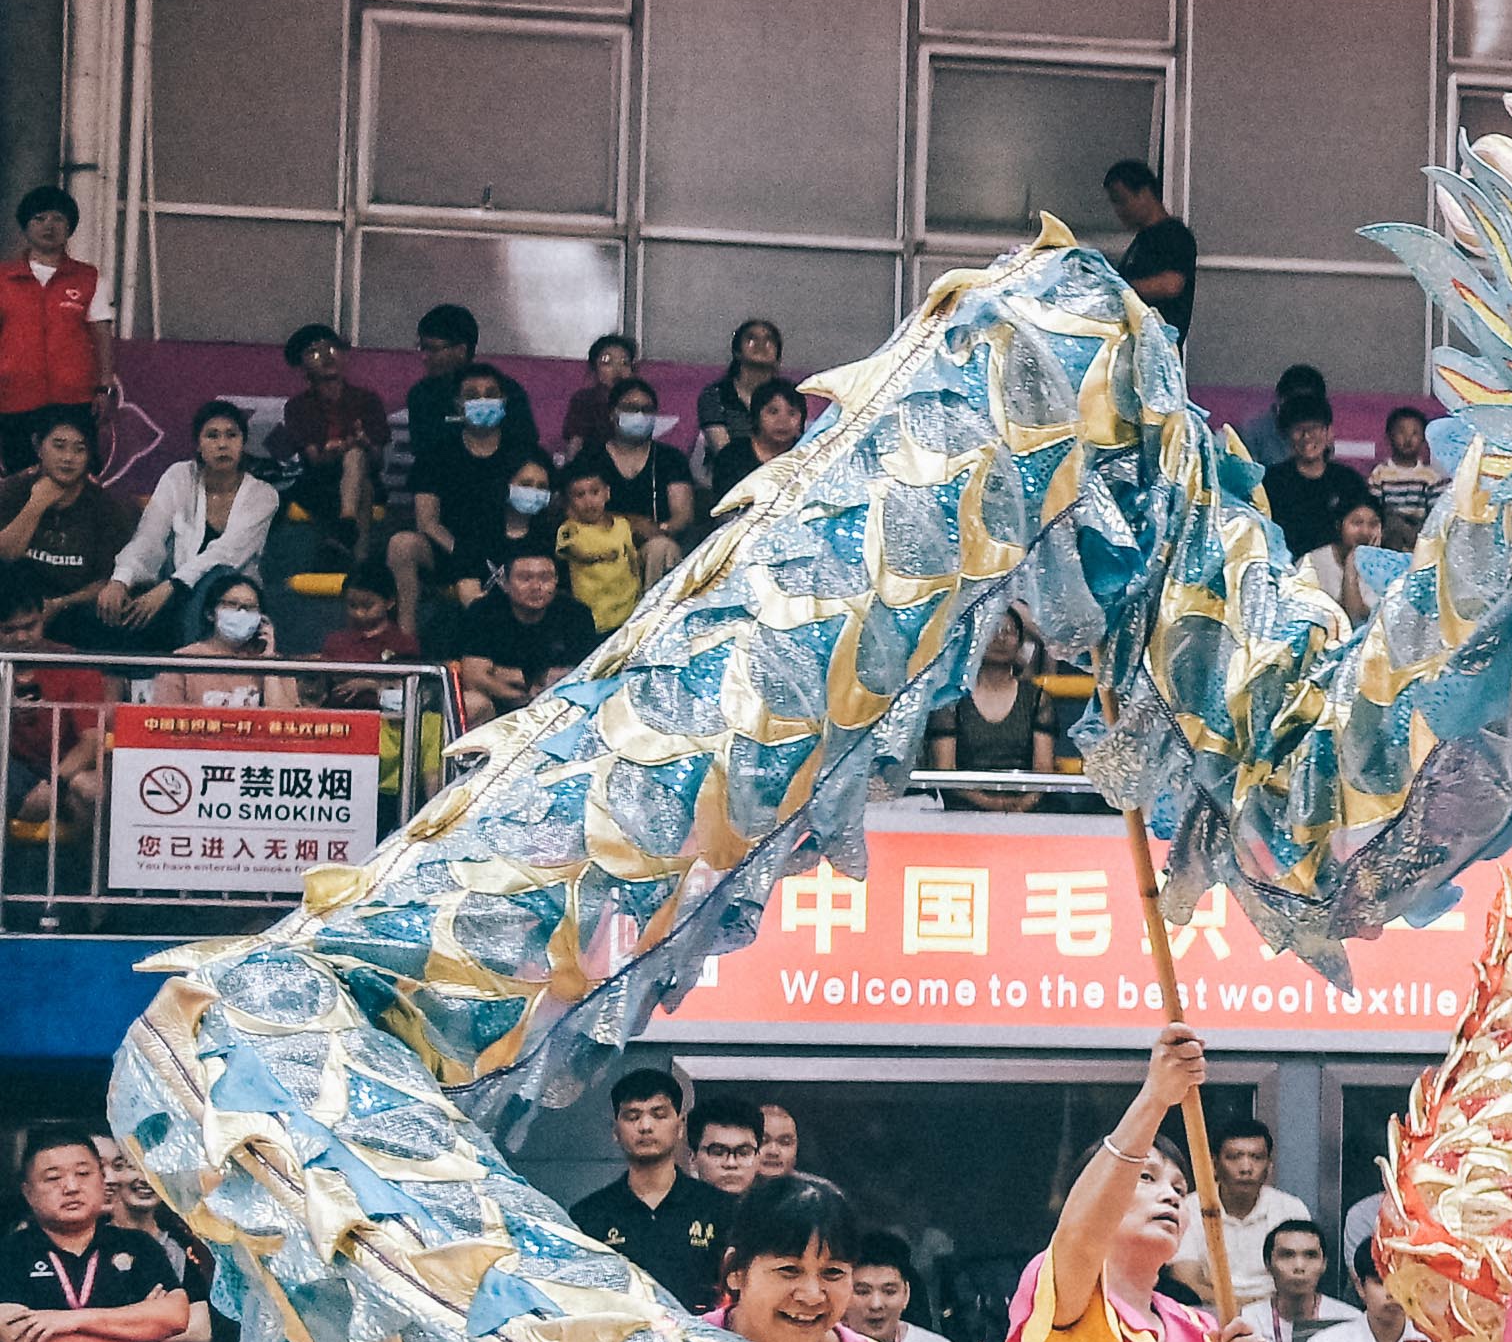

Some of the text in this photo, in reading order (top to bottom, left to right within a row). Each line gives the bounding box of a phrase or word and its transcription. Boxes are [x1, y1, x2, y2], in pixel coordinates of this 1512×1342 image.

[200, 765, 352, 801] 严禁吸烟
[198, 802, 351, 823] NO SMOKING
[137, 834, 349, 862] 您已进入无烟区
[780, 969, 976, 1008] Welcome
[990, 973, 1028, 1008] to
[1040, 972, 1104, 1009] the
[1117, 976, 1207, 1013] best
[1219, 979, 1312, 1014] wool
[1324, 979, 1457, 1016] textile
